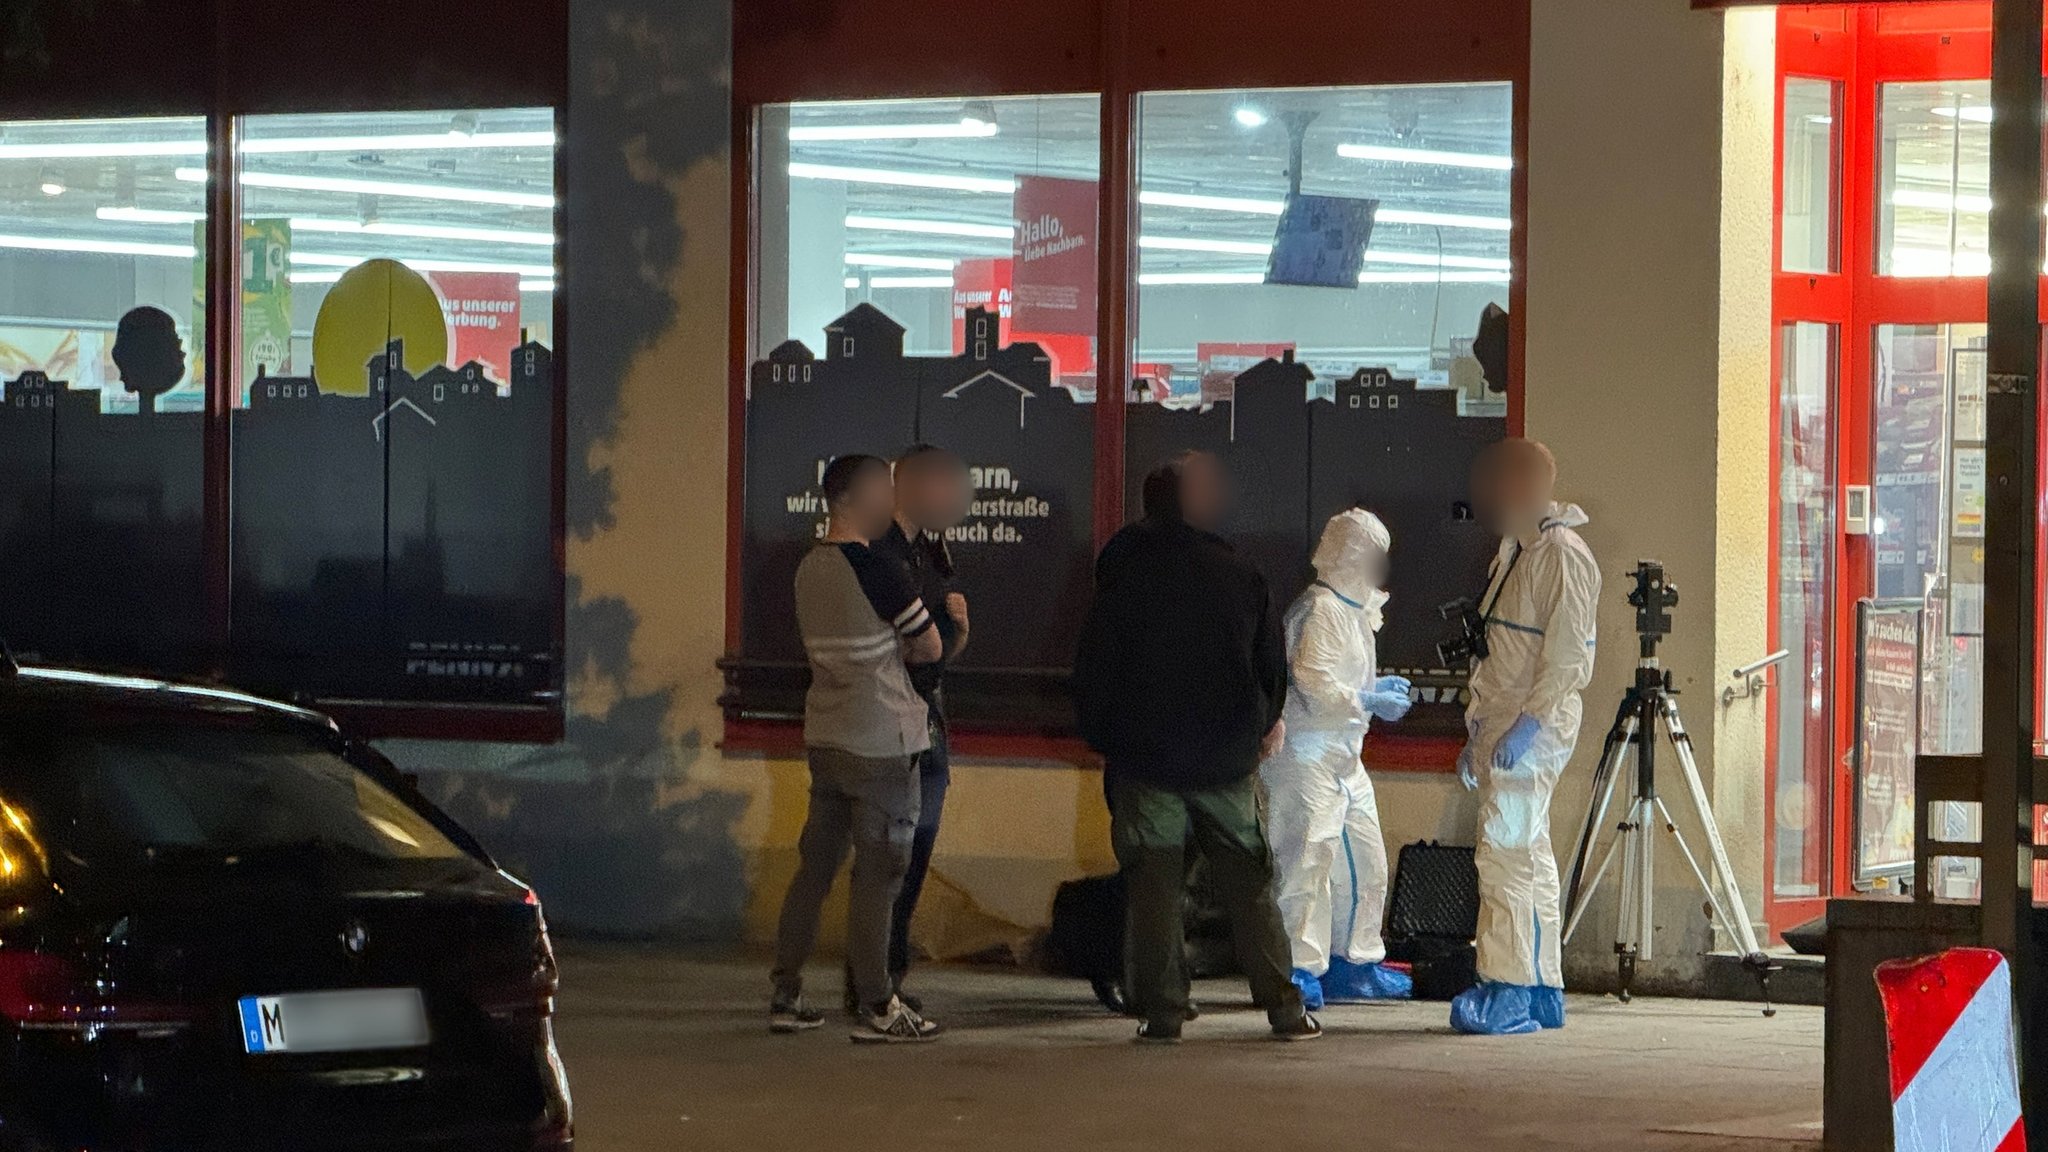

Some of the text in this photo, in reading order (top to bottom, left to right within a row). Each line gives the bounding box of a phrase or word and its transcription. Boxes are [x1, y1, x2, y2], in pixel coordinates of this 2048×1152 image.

[1020, 214, 1064, 246] Hallo,
[1024, 244, 1046, 262] liebe
[442, 298, 516, 313] us unserer
[446, 312, 501, 330] erbung.
[786, 491, 819, 513] wir
[966, 496, 1050, 517] erstraße
[944, 521, 988, 542] euch
[992, 521, 1023, 542] da.
[262, 1003, 285, 1044] M
[250, 1029, 259, 1043] D
